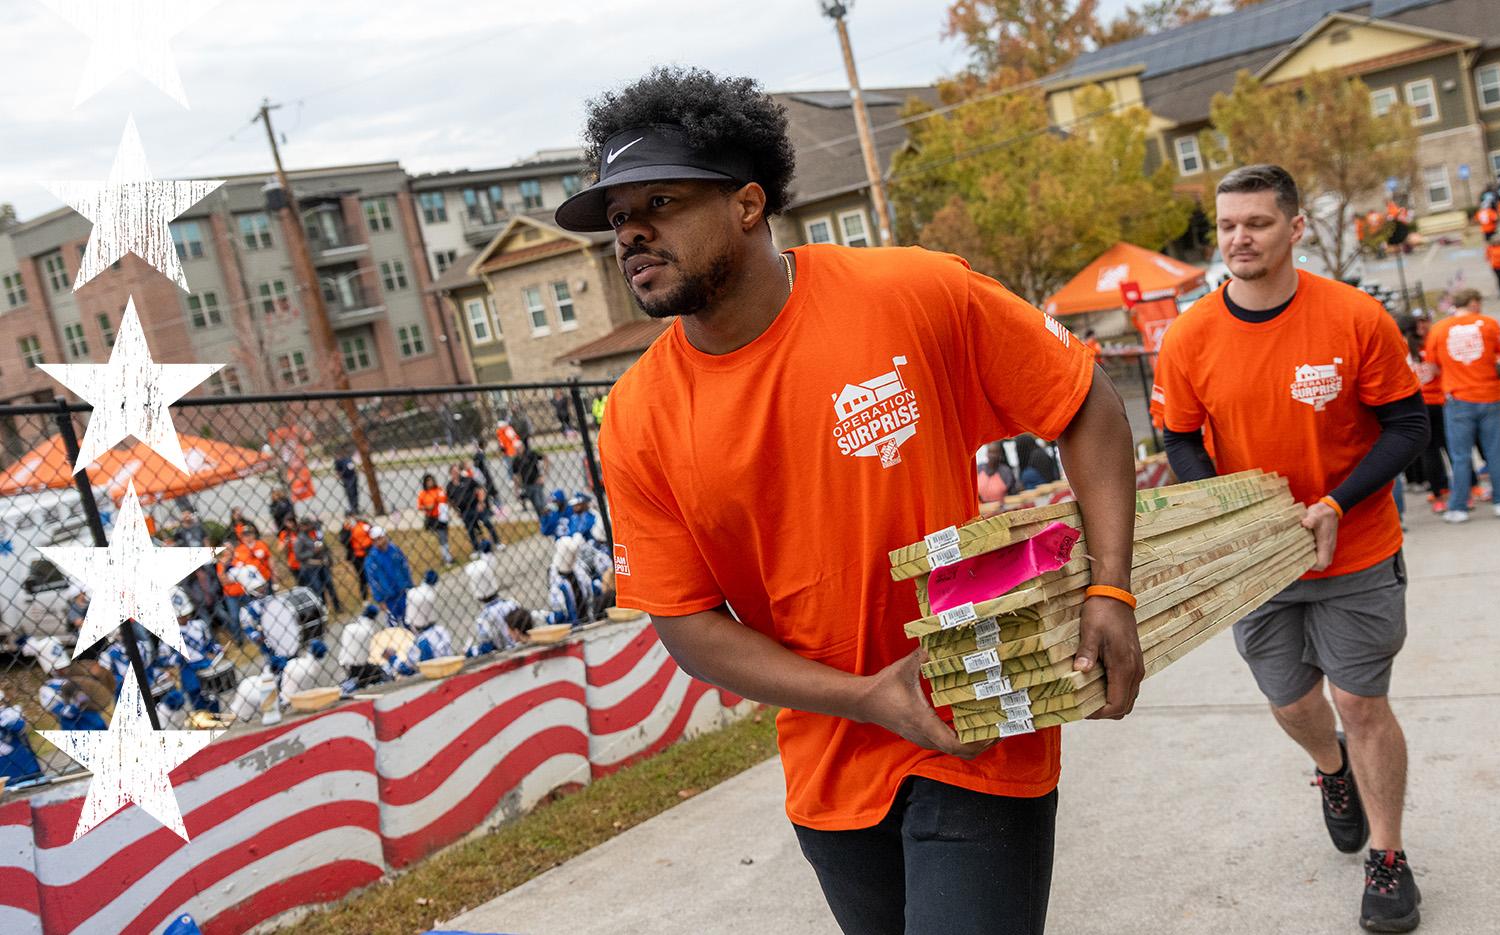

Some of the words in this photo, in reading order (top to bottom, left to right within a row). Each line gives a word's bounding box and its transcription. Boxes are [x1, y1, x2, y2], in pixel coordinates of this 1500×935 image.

[833, 390, 915, 438] OPERATION
[1291, 384, 1343, 400] SURPRISE
[837, 401, 920, 455] SURPRISE
